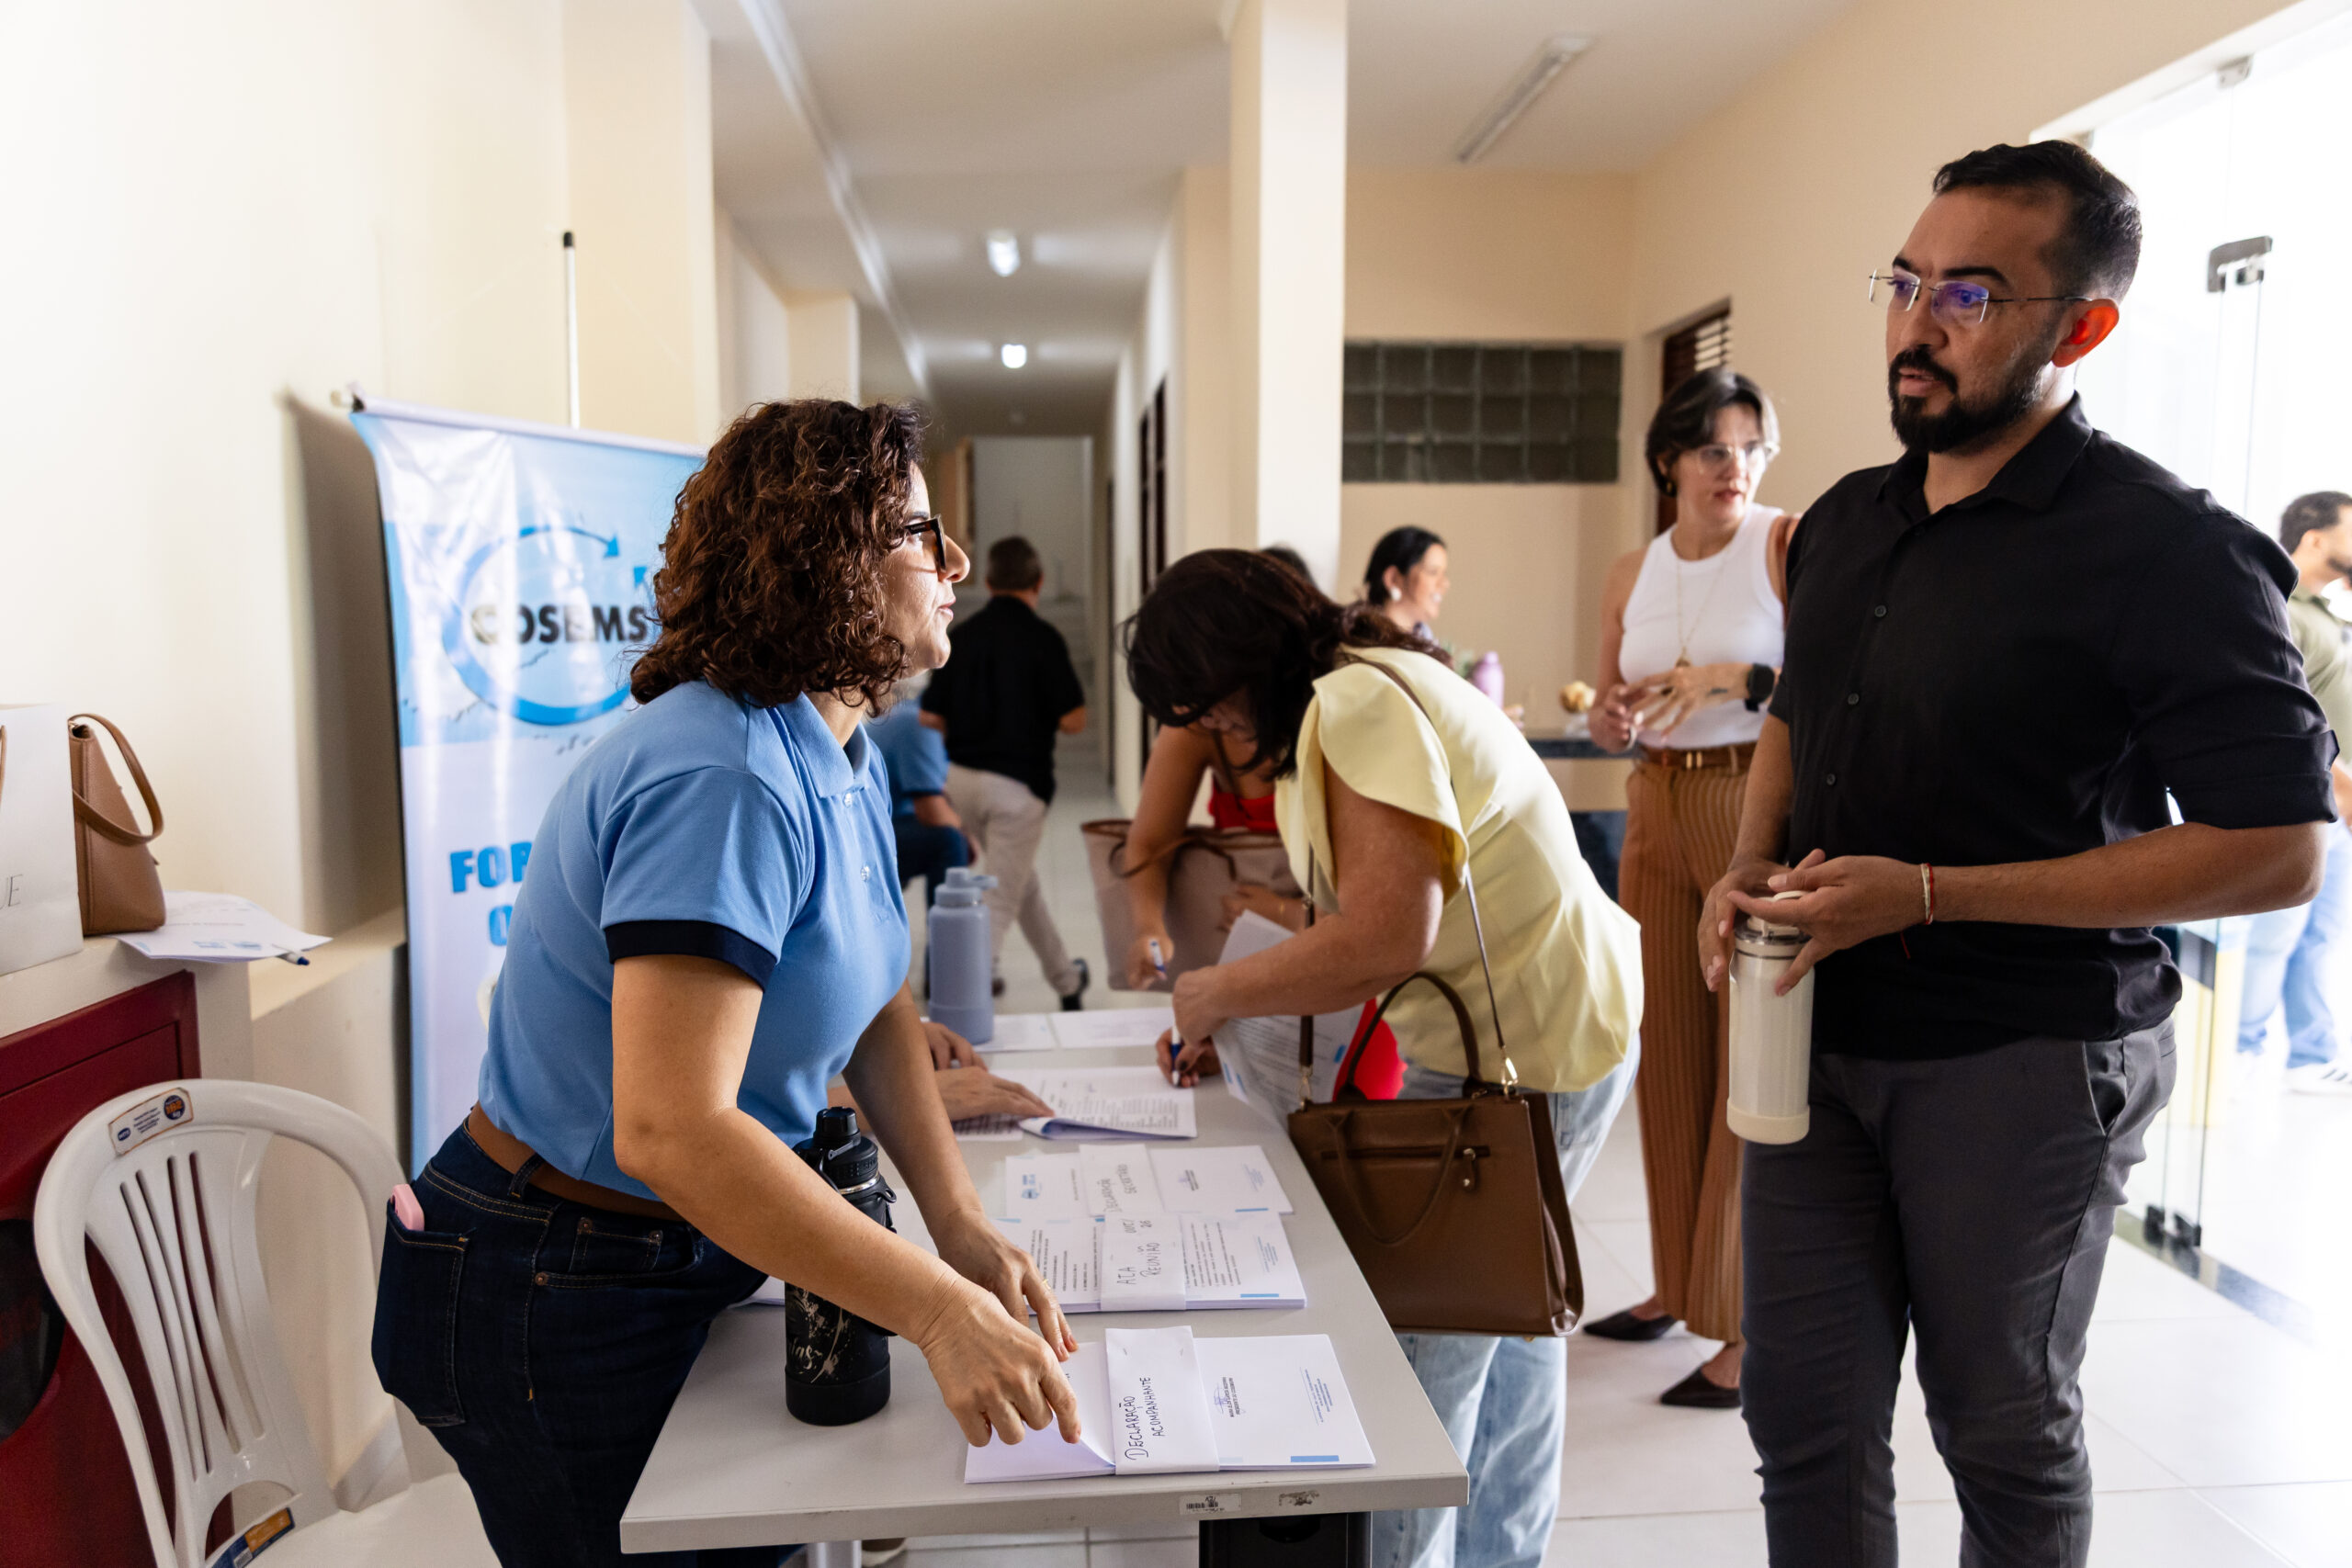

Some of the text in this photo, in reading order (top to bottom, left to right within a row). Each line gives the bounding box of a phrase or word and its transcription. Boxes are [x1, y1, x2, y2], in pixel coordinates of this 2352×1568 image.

[470, 604, 648, 645] COSEMS
[1116, 1267, 1136, 1285] ATA
[1137, 1242, 1162, 1278] REUNIÃO
[1139, 1377, 1166, 1437] ACOMPANHANTE
[1118, 1395, 1149, 1461] DECLARAÇÃO
